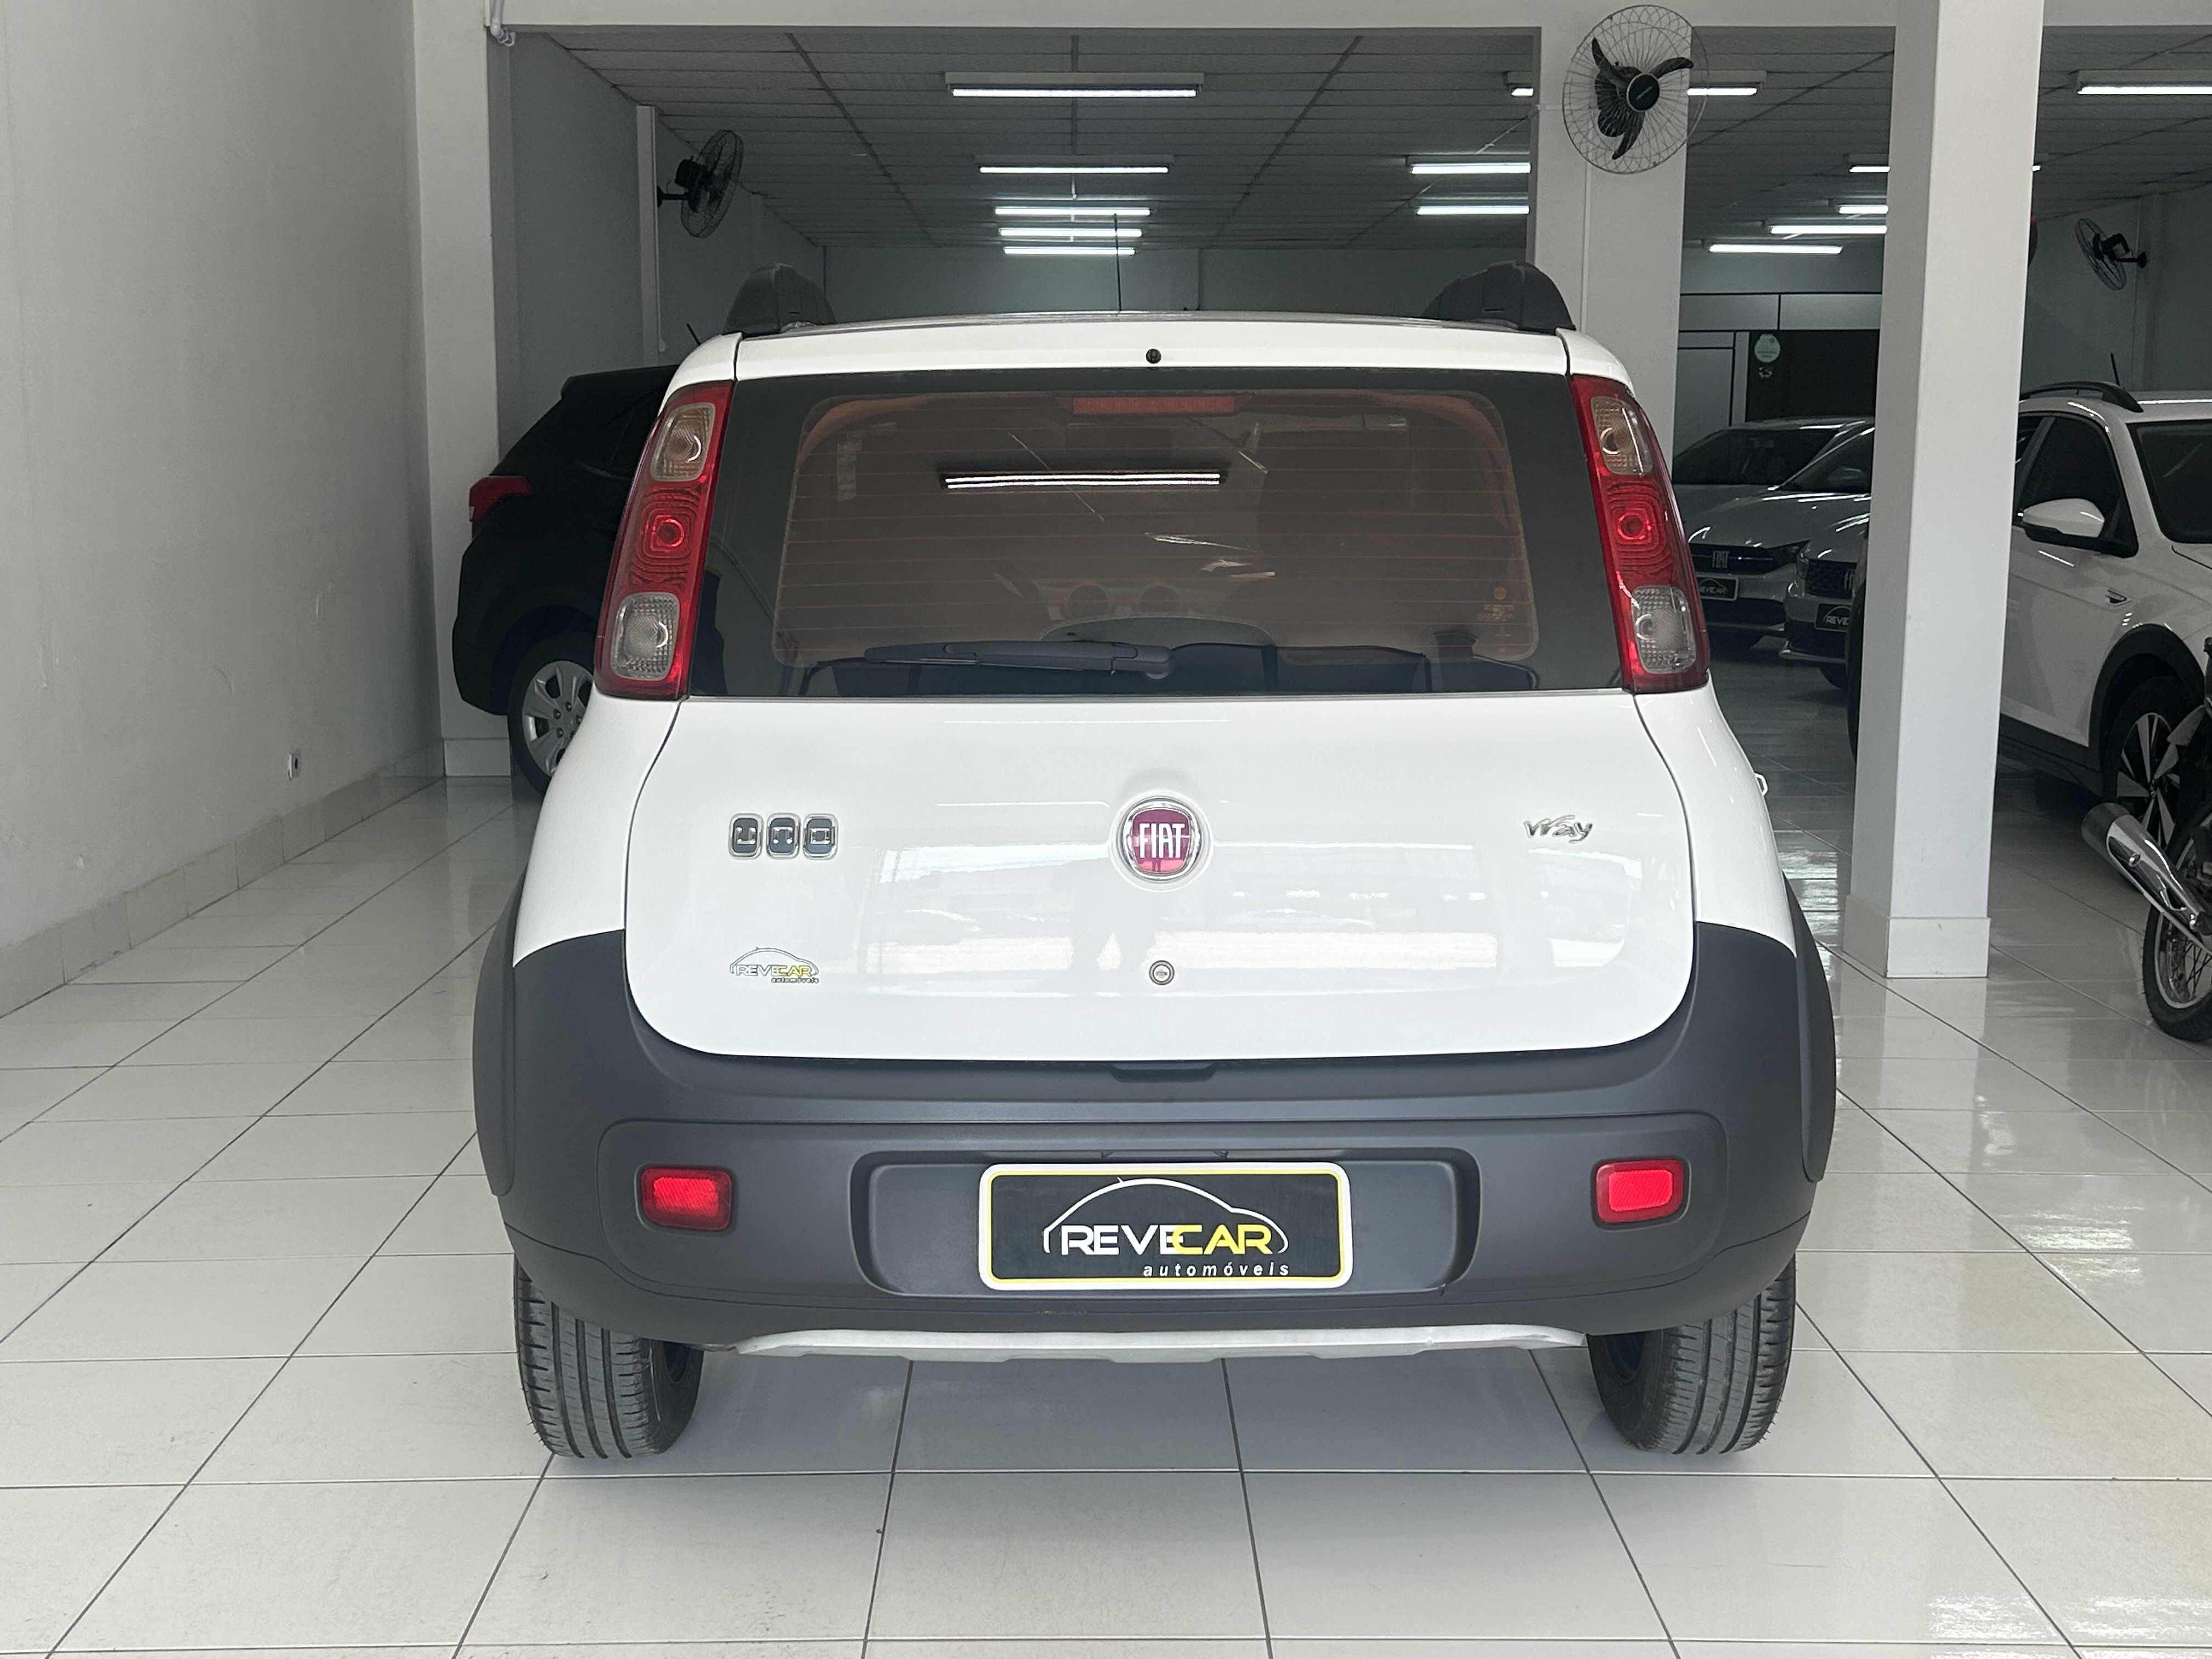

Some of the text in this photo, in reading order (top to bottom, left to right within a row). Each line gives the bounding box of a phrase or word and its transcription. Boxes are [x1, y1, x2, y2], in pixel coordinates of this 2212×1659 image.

[1712, 550, 1730, 568] FIAT
[1138, 822, 1186, 859] FIAT
[735, 964, 812, 977] REVECAR
[1060, 1224, 1273, 1255] REVECAR
[1142, 1261, 1290, 1277] automóveis
